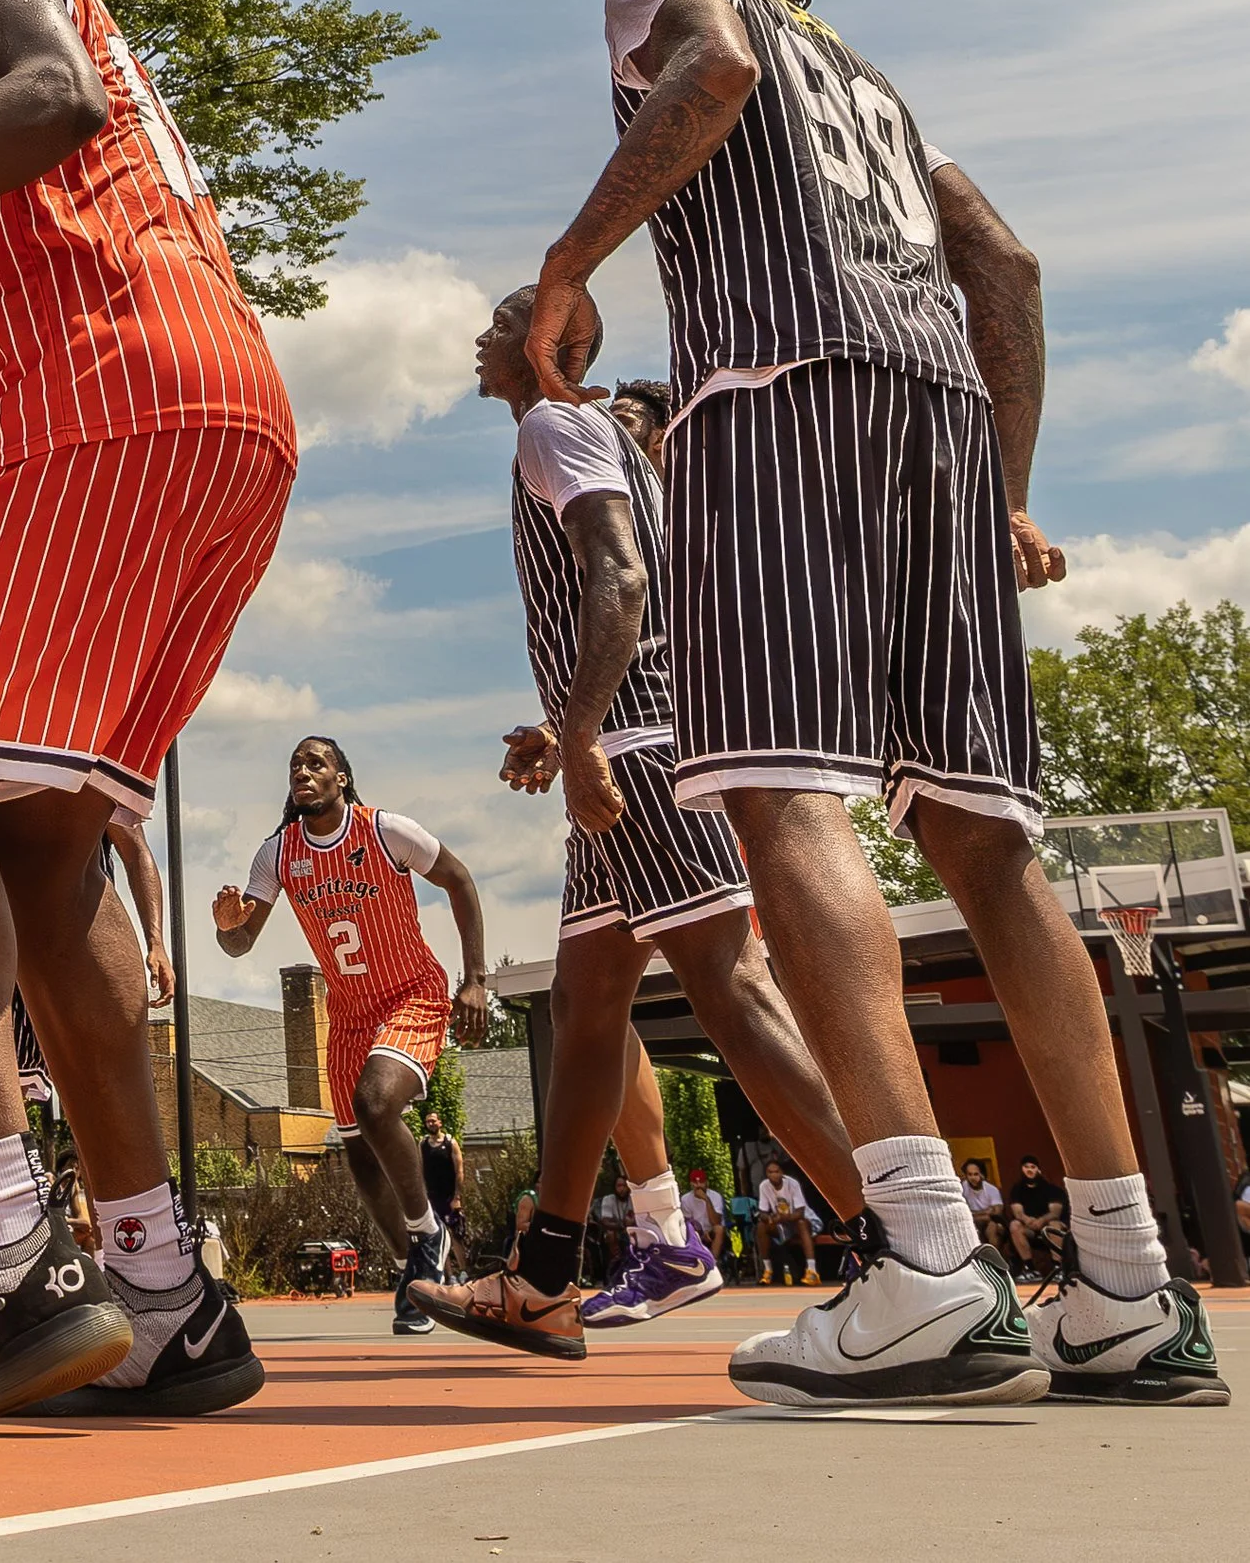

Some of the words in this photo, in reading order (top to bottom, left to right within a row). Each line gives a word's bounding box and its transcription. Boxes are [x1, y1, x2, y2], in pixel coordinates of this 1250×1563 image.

[295, 877, 380, 908] Heritage
[315, 901, 362, 918] Classic
[327, 919, 368, 975] 2
[27, 1148, 46, 1175] RUN
[173, 1193, 185, 1221] RUN
